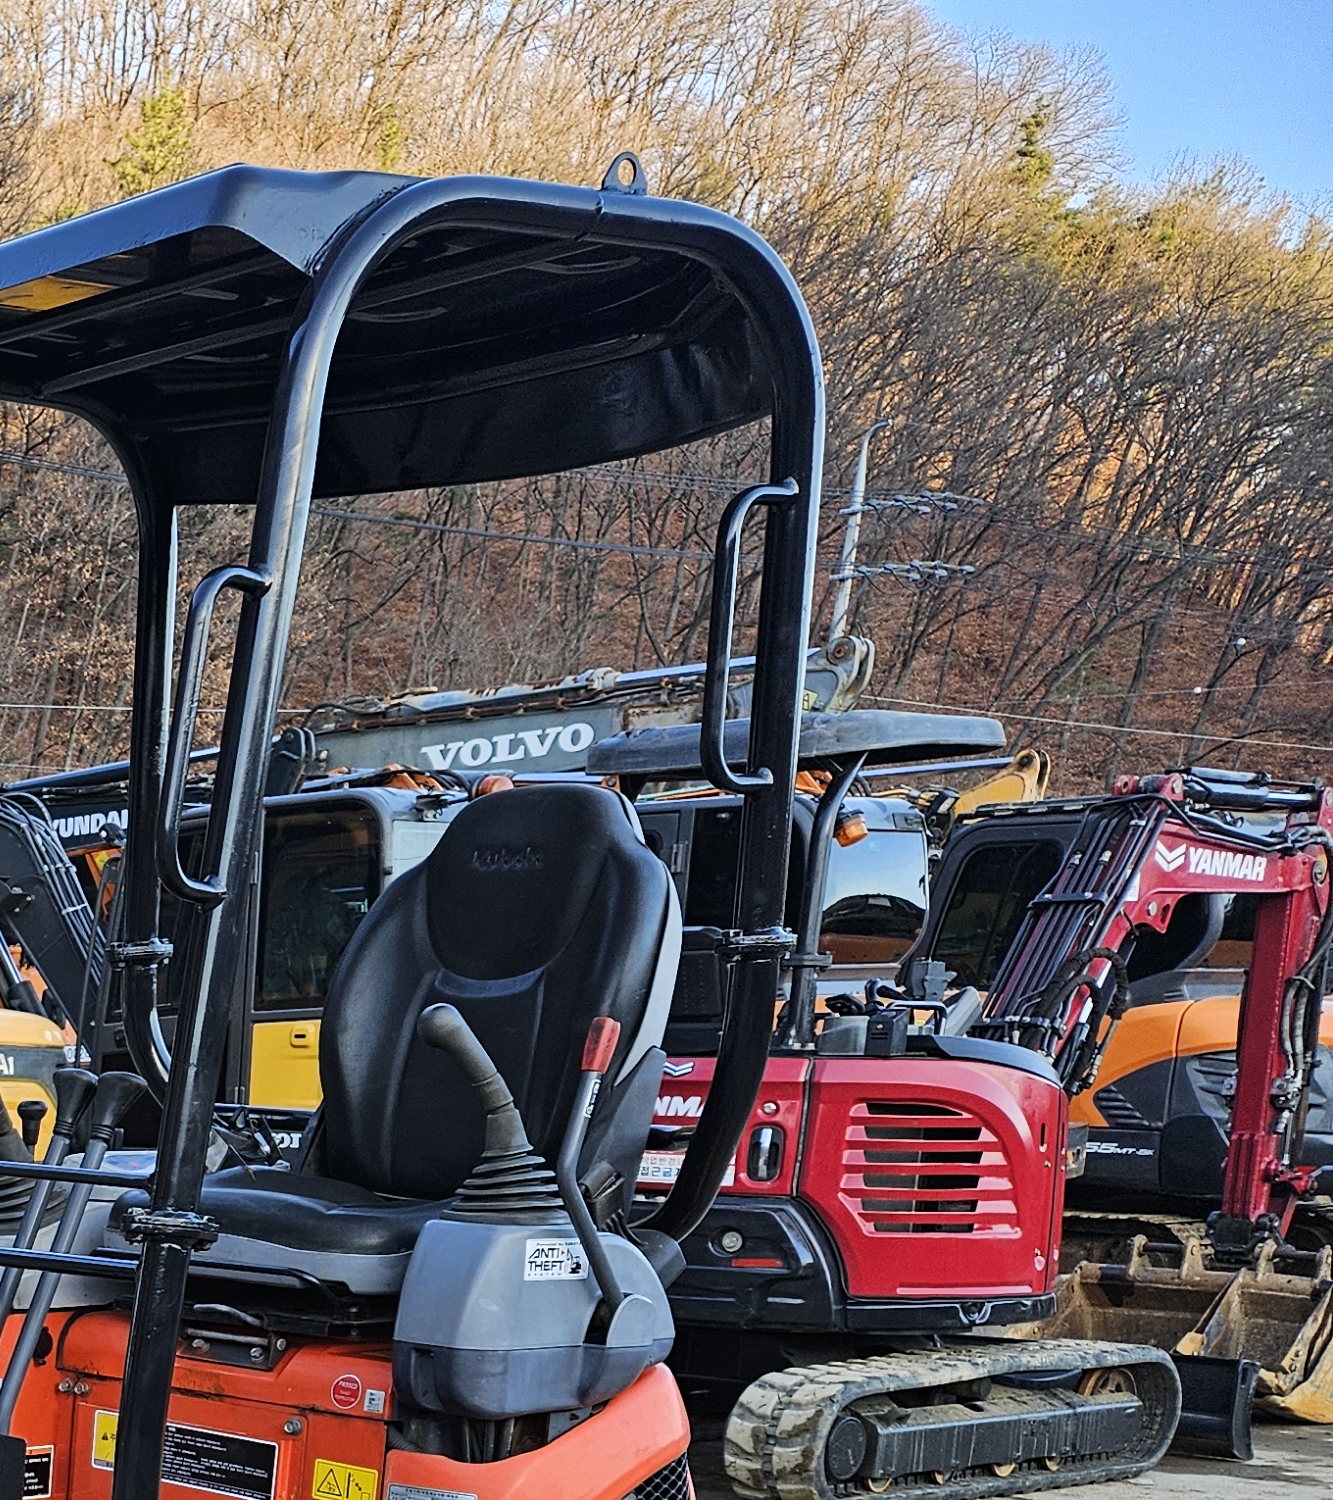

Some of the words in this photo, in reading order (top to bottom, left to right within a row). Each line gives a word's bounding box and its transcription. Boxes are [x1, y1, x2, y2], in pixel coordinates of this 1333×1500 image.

[420, 723, 595, 770] VOLVO
[52, 808, 129, 838] UNDAI
[1188, 846, 1267, 882] YANMAR
[527, 1260, 565, 1272] THEFT
[528, 1247, 560, 1260] ANTI
